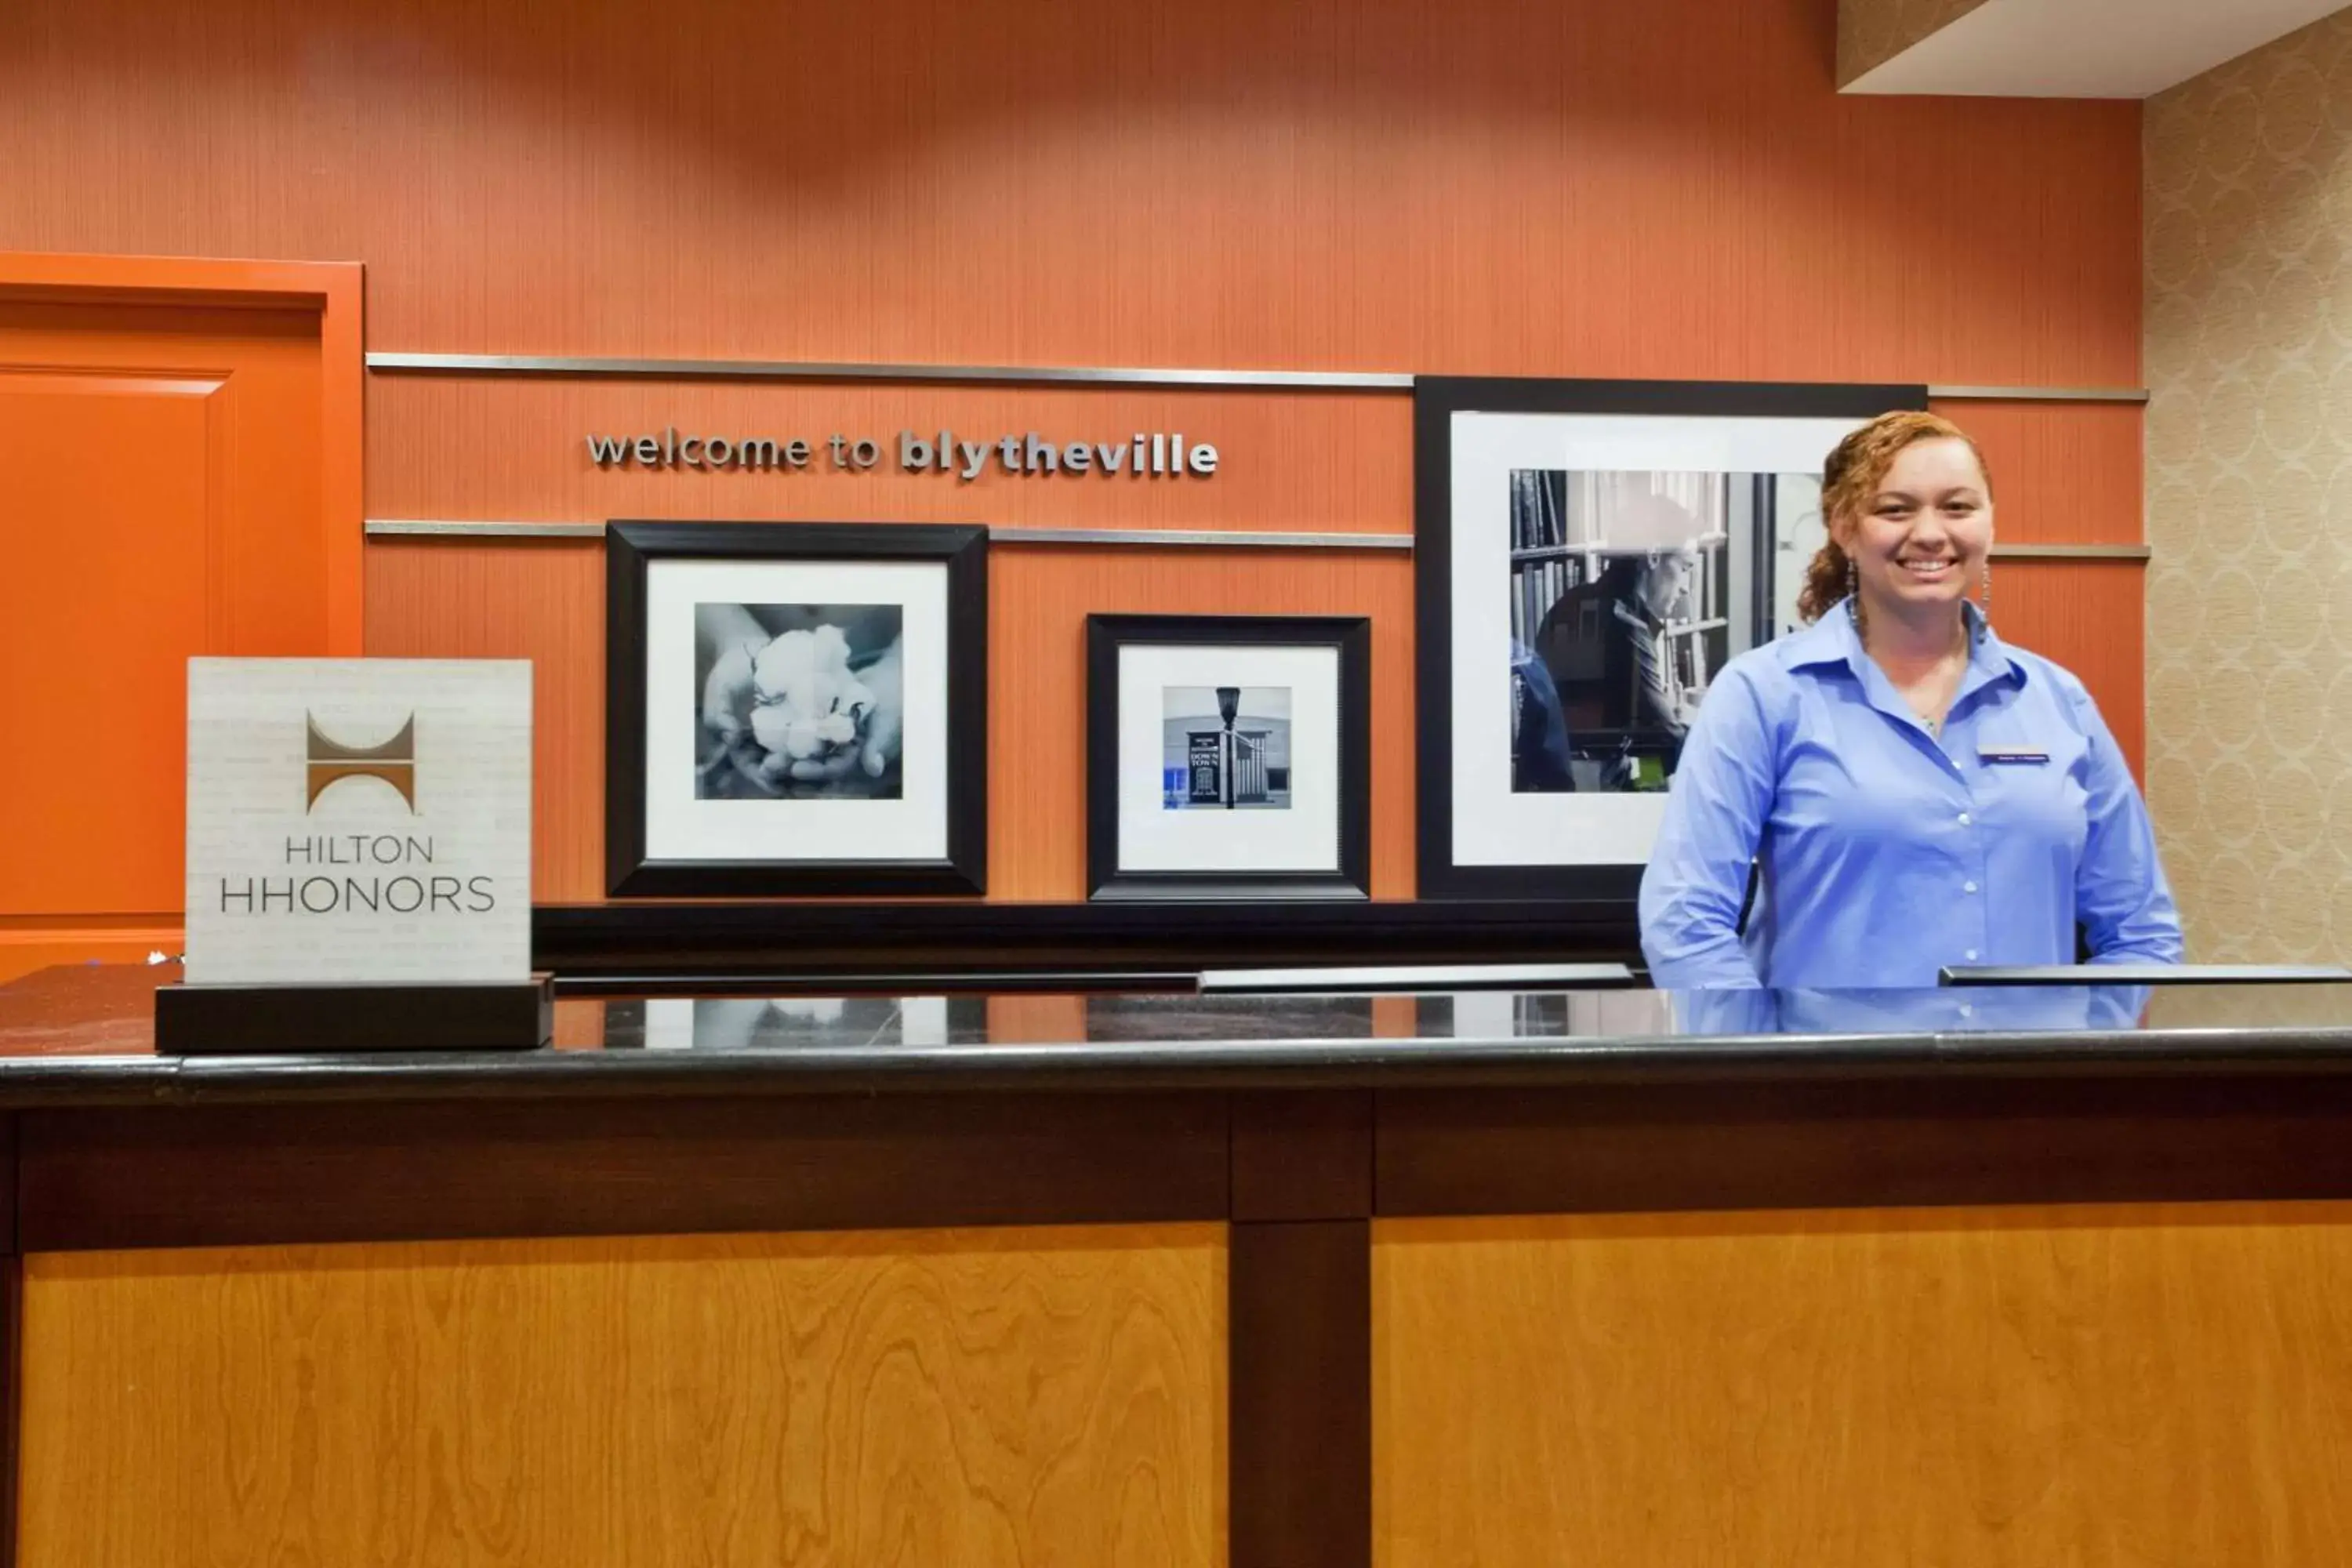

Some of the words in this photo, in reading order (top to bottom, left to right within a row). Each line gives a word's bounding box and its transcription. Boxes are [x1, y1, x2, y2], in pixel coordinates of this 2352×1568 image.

[586, 426, 811, 467] welcome
[829, 433, 880, 466] to
[900, 429, 1219, 479] blytheville
[286, 835, 433, 864] HILTON
[220, 876, 495, 913] HHONORS
